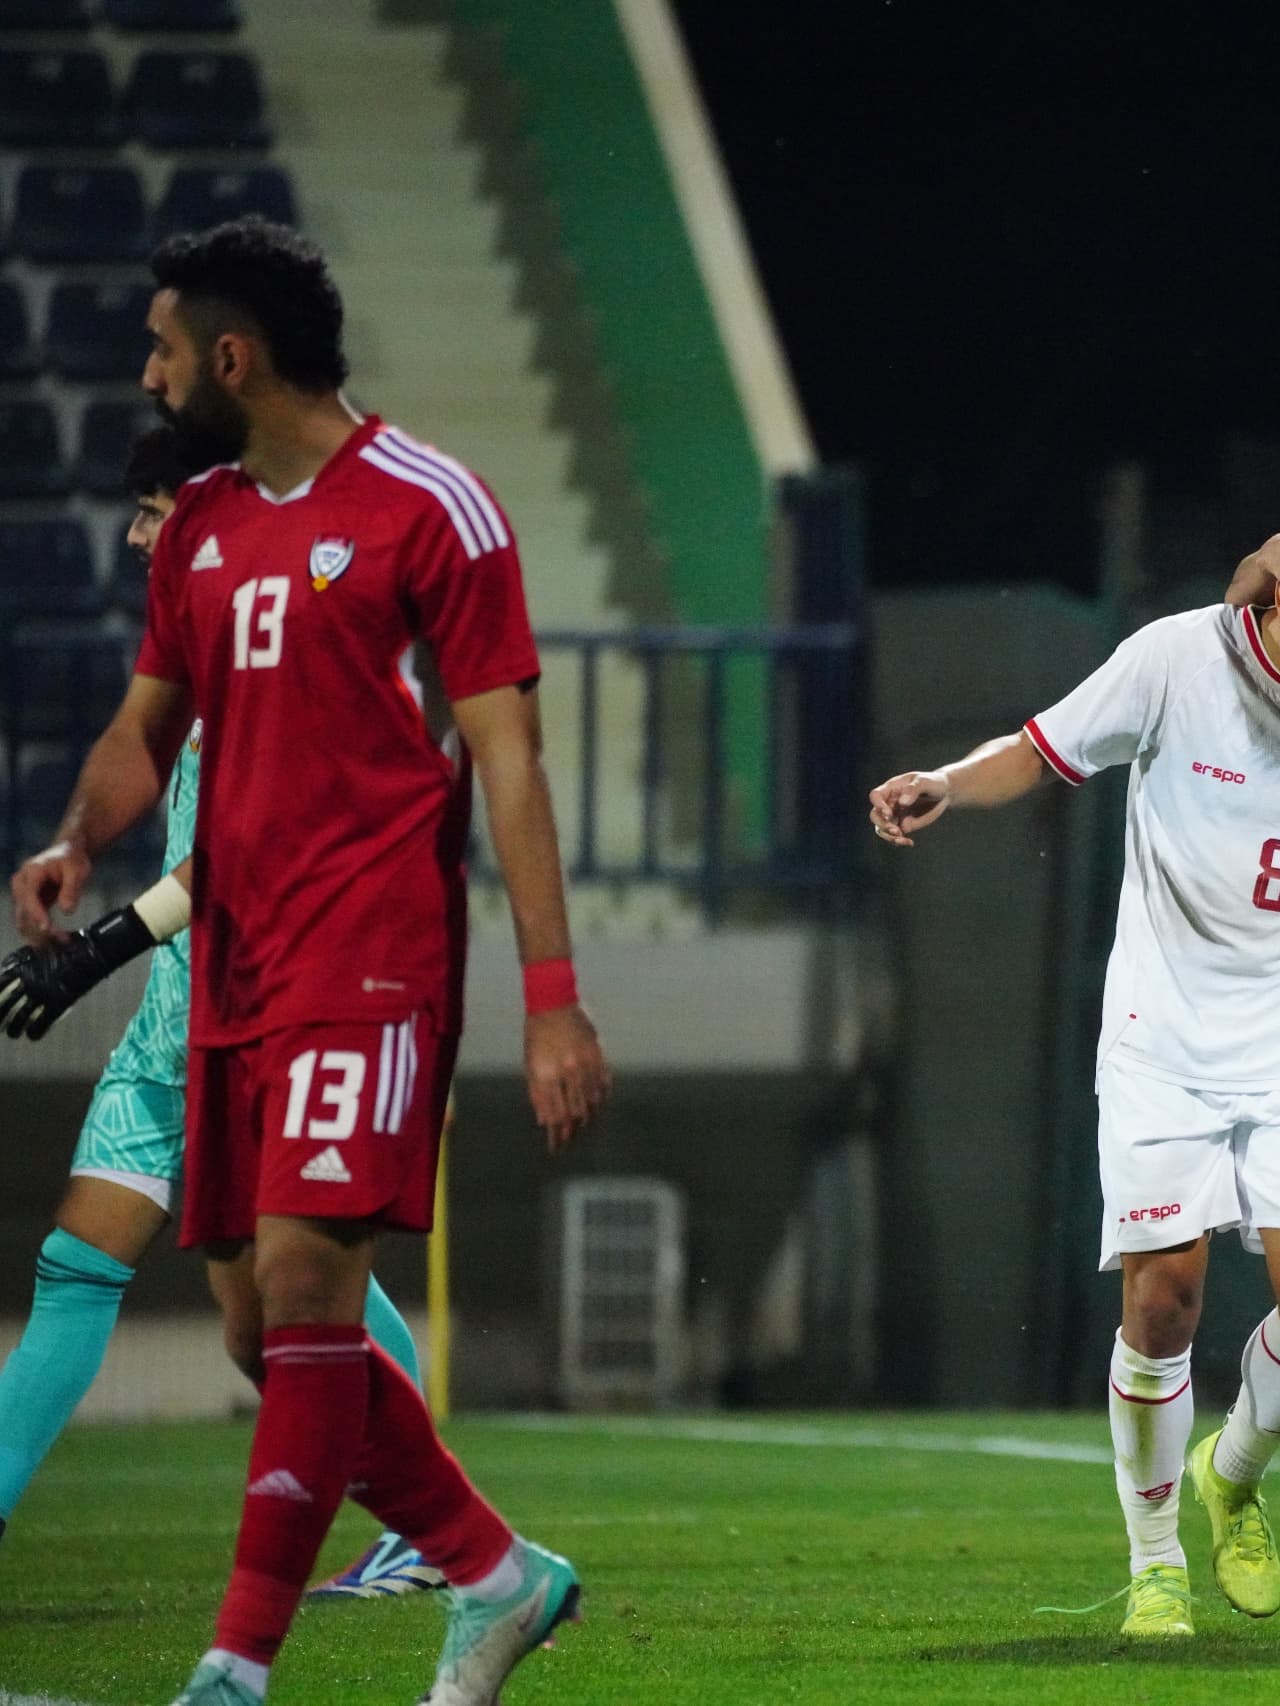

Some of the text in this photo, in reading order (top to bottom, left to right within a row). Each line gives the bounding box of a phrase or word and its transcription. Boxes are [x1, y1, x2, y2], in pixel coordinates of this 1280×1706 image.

[232, 575, 290, 670] 13
[1191, 761, 1246, 785] erspo
[282, 1049, 367, 1140] 13
[1129, 1203, 1182, 1221] erspo
